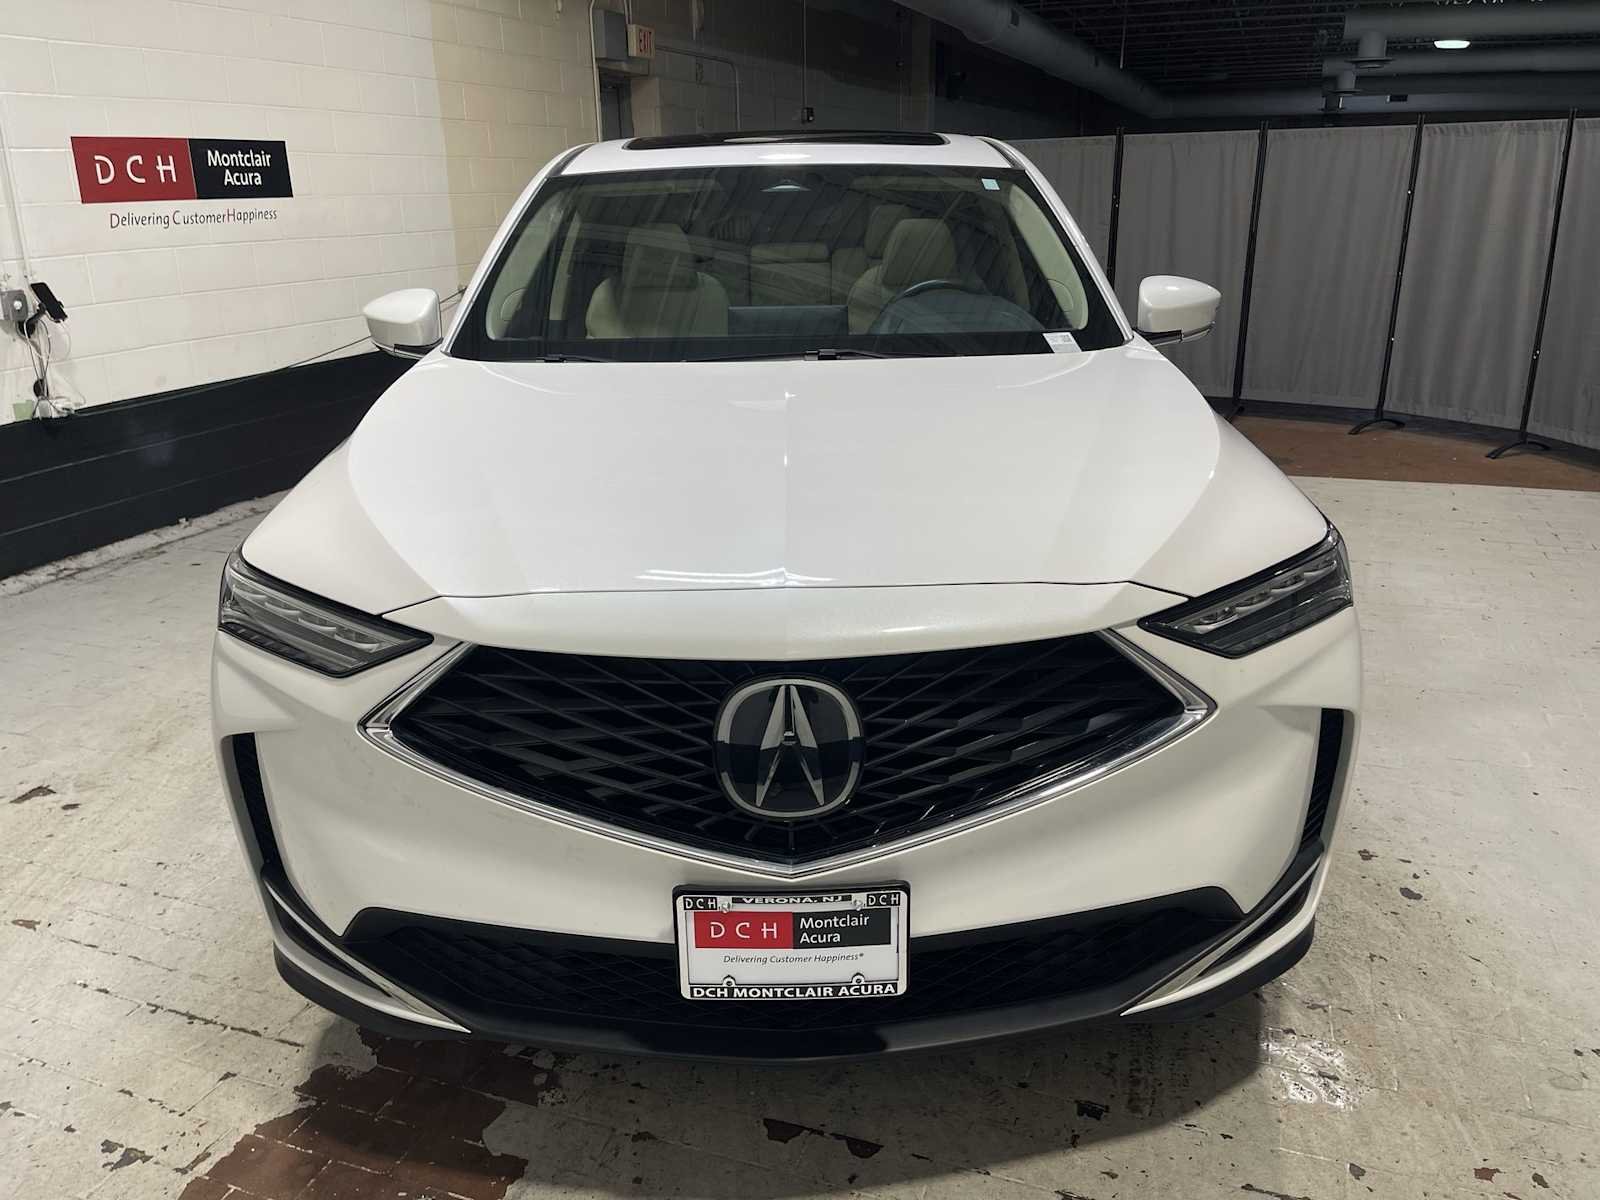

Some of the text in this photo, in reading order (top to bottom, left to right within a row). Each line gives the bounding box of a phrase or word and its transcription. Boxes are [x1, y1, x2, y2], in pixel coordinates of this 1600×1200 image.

[638, 29, 653, 55] EXIT
[207, 149, 272, 168] Montclair
[224, 171, 262, 186] Acura
[109, 208, 278, 229] Delivering Customer Happiness
[800, 914, 870, 929] Montclair
[800, 932, 841, 944] Acura
[723, 955, 768, 965] Delivering
[770, 954, 813, 963] Customer
[693, 983, 896, 998] DCH MONTCLAIR ACURA
